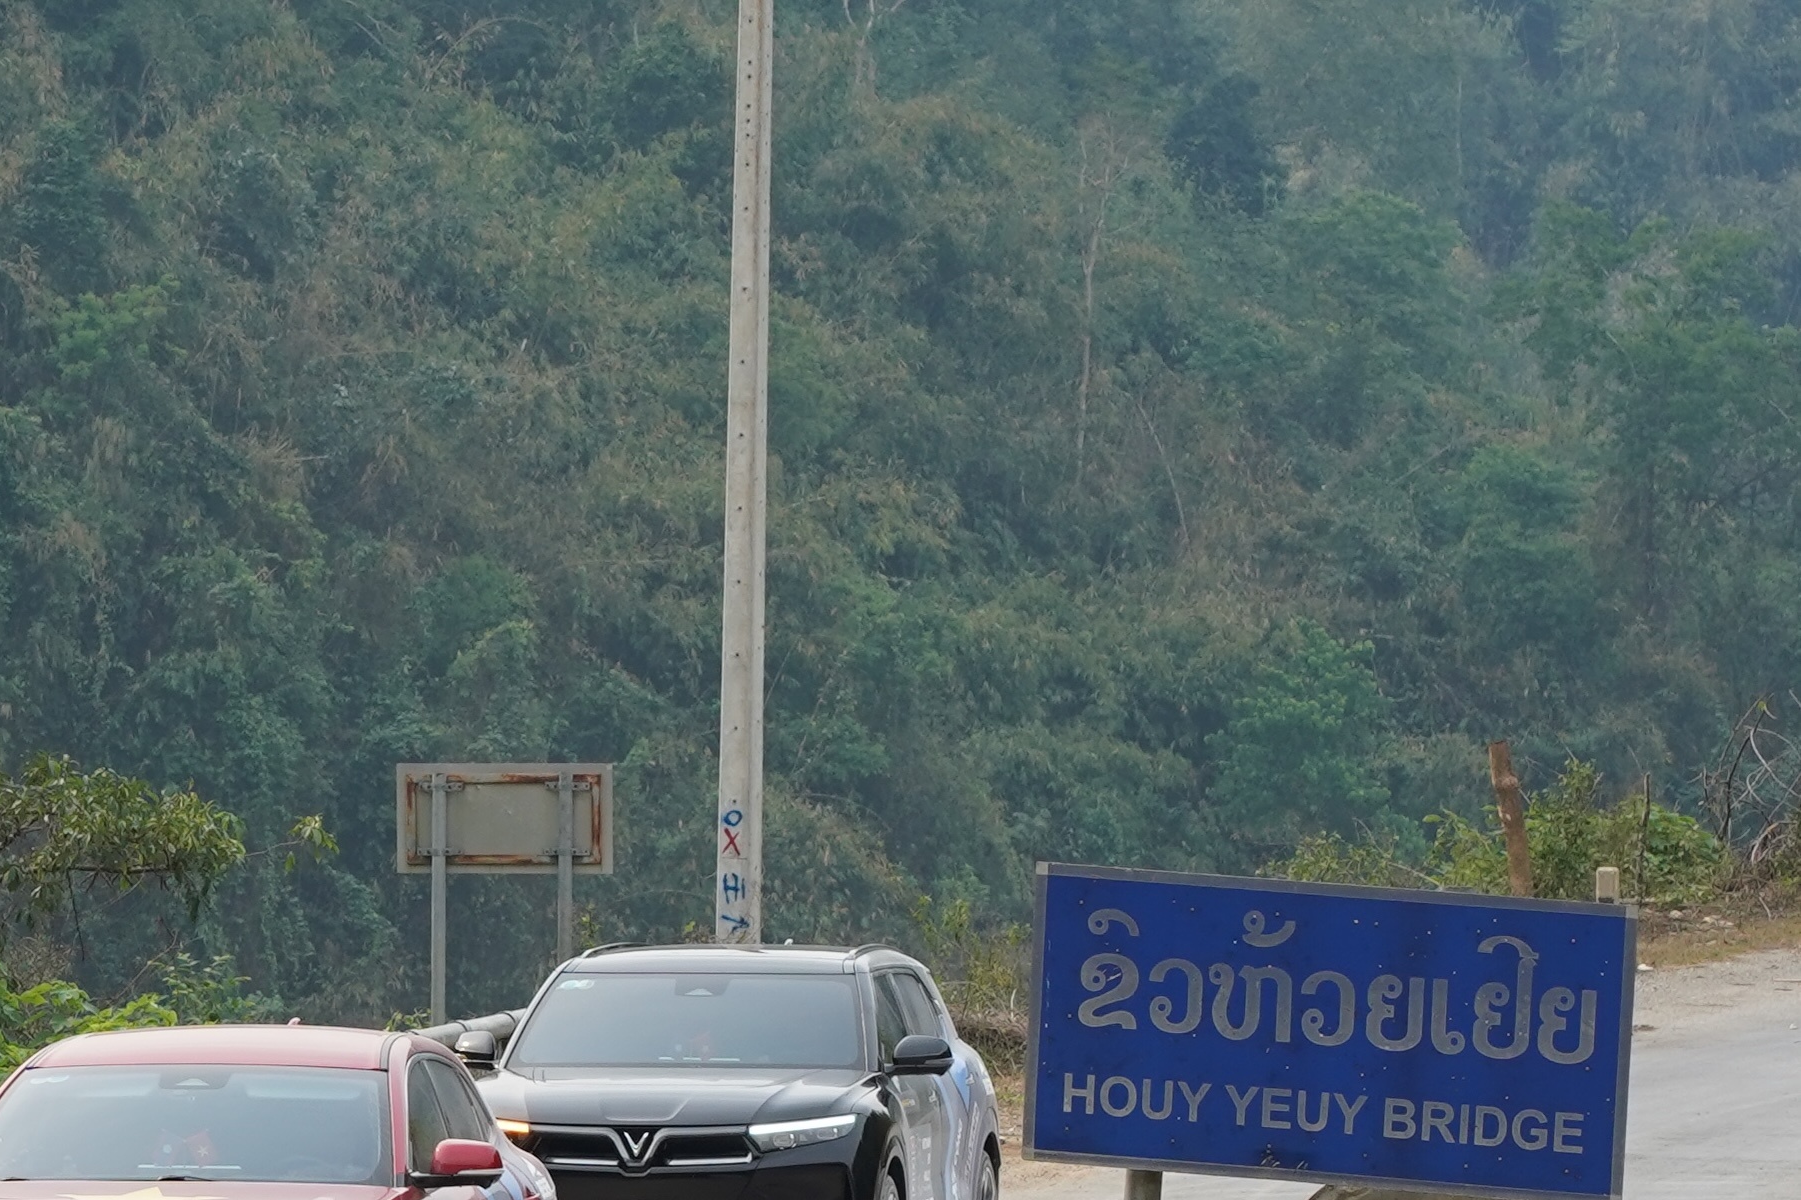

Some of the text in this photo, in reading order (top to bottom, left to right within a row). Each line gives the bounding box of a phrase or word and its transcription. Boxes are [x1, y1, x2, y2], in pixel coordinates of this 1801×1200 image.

[1063, 1072, 1585, 1155] HOUY YEUY BRIDGE
